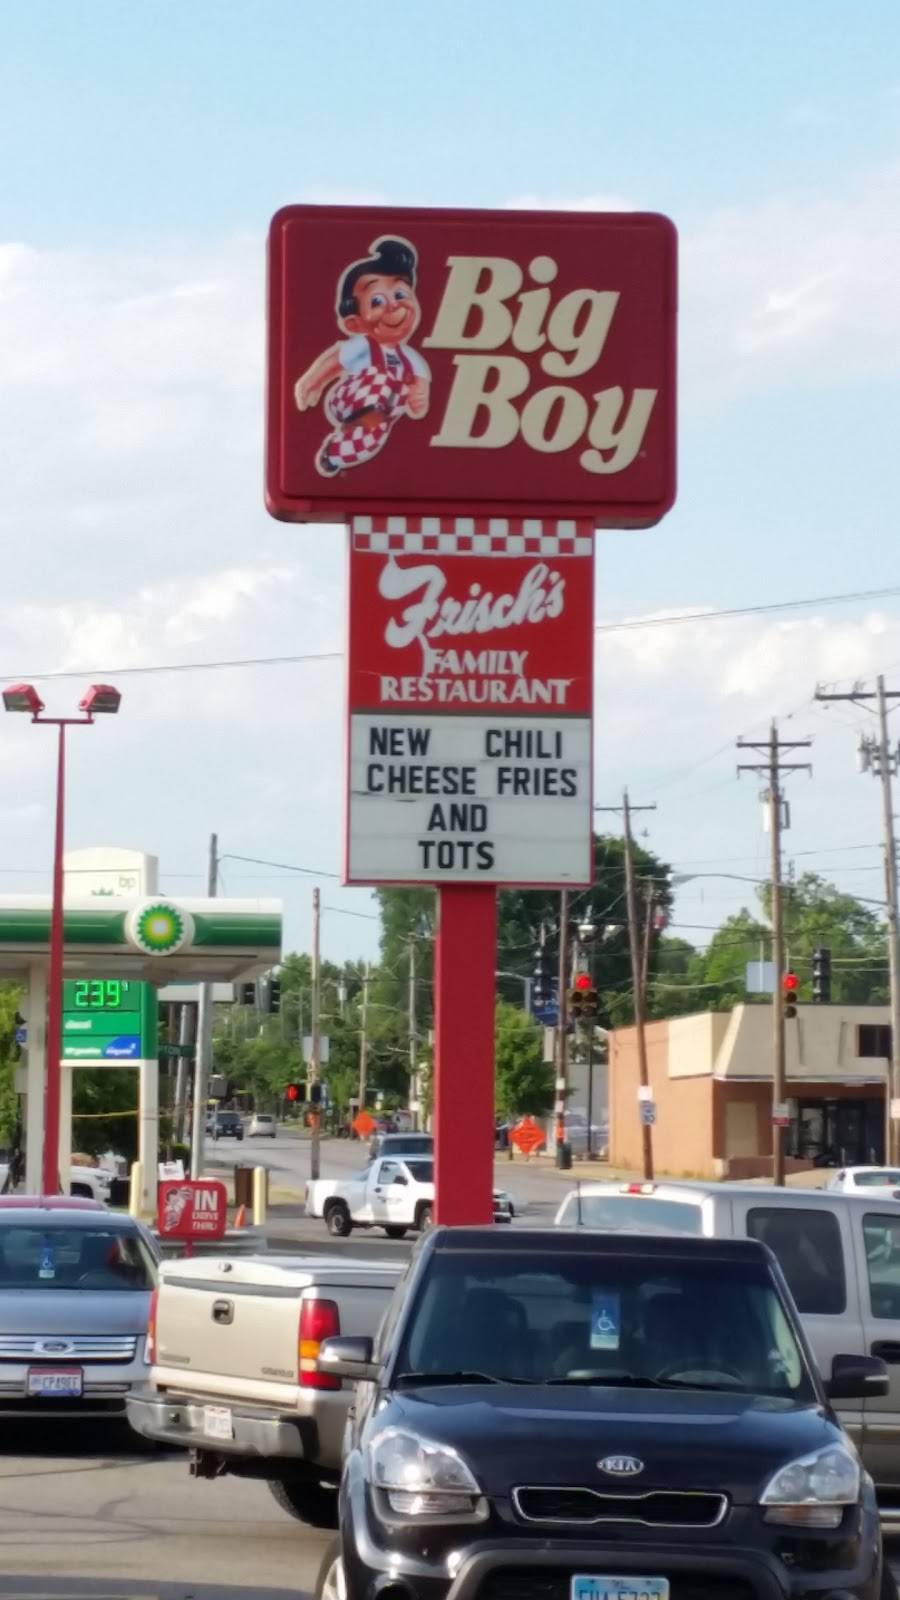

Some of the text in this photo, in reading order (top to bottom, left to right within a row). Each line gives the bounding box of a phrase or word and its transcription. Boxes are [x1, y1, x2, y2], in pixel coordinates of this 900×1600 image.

[422, 256, 620, 378] Big
[430, 355, 658, 474] Boy
[379, 554, 565, 648] Frisch's
[425, 650, 529, 676] FAMILY
[380, 676, 572, 705] RESTAURANT
[369, 727, 563, 760] NEW CHILI
[366, 763, 578, 797] CHEESE FRIES
[427, 803, 489, 833] AND
[418, 840, 495, 871] TOTS
[194, 1189, 218, 1211] IN
[606, 1459, 637, 1471] KIA
